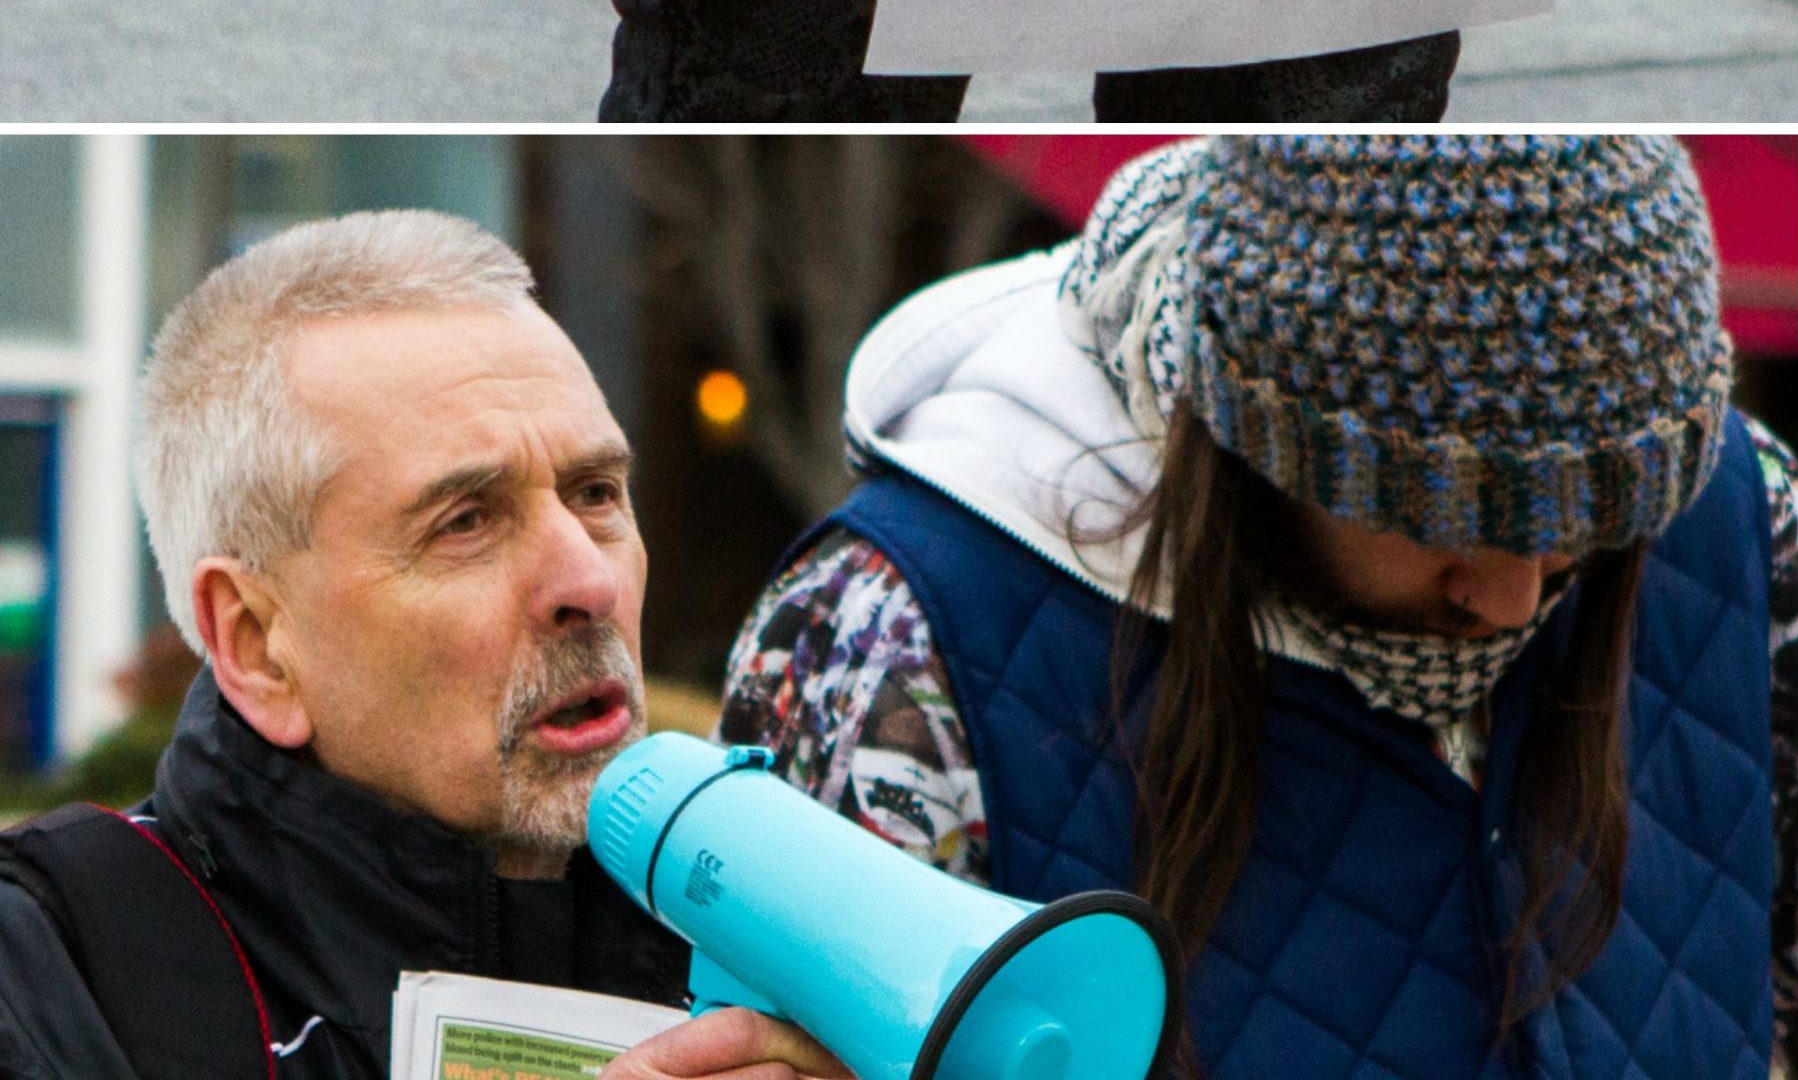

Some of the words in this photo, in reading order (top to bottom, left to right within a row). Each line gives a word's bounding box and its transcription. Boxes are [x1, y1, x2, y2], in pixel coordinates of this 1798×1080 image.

[446, 1027, 473, 1039] More
[474, 1033, 503, 1043] police
[504, 1037, 525, 1047] with
[526, 1042, 571, 1056] increased
[446, 1043, 473, 1054] blood
[474, 1047, 501, 1061] being
[537, 1055, 552, 1067] the
